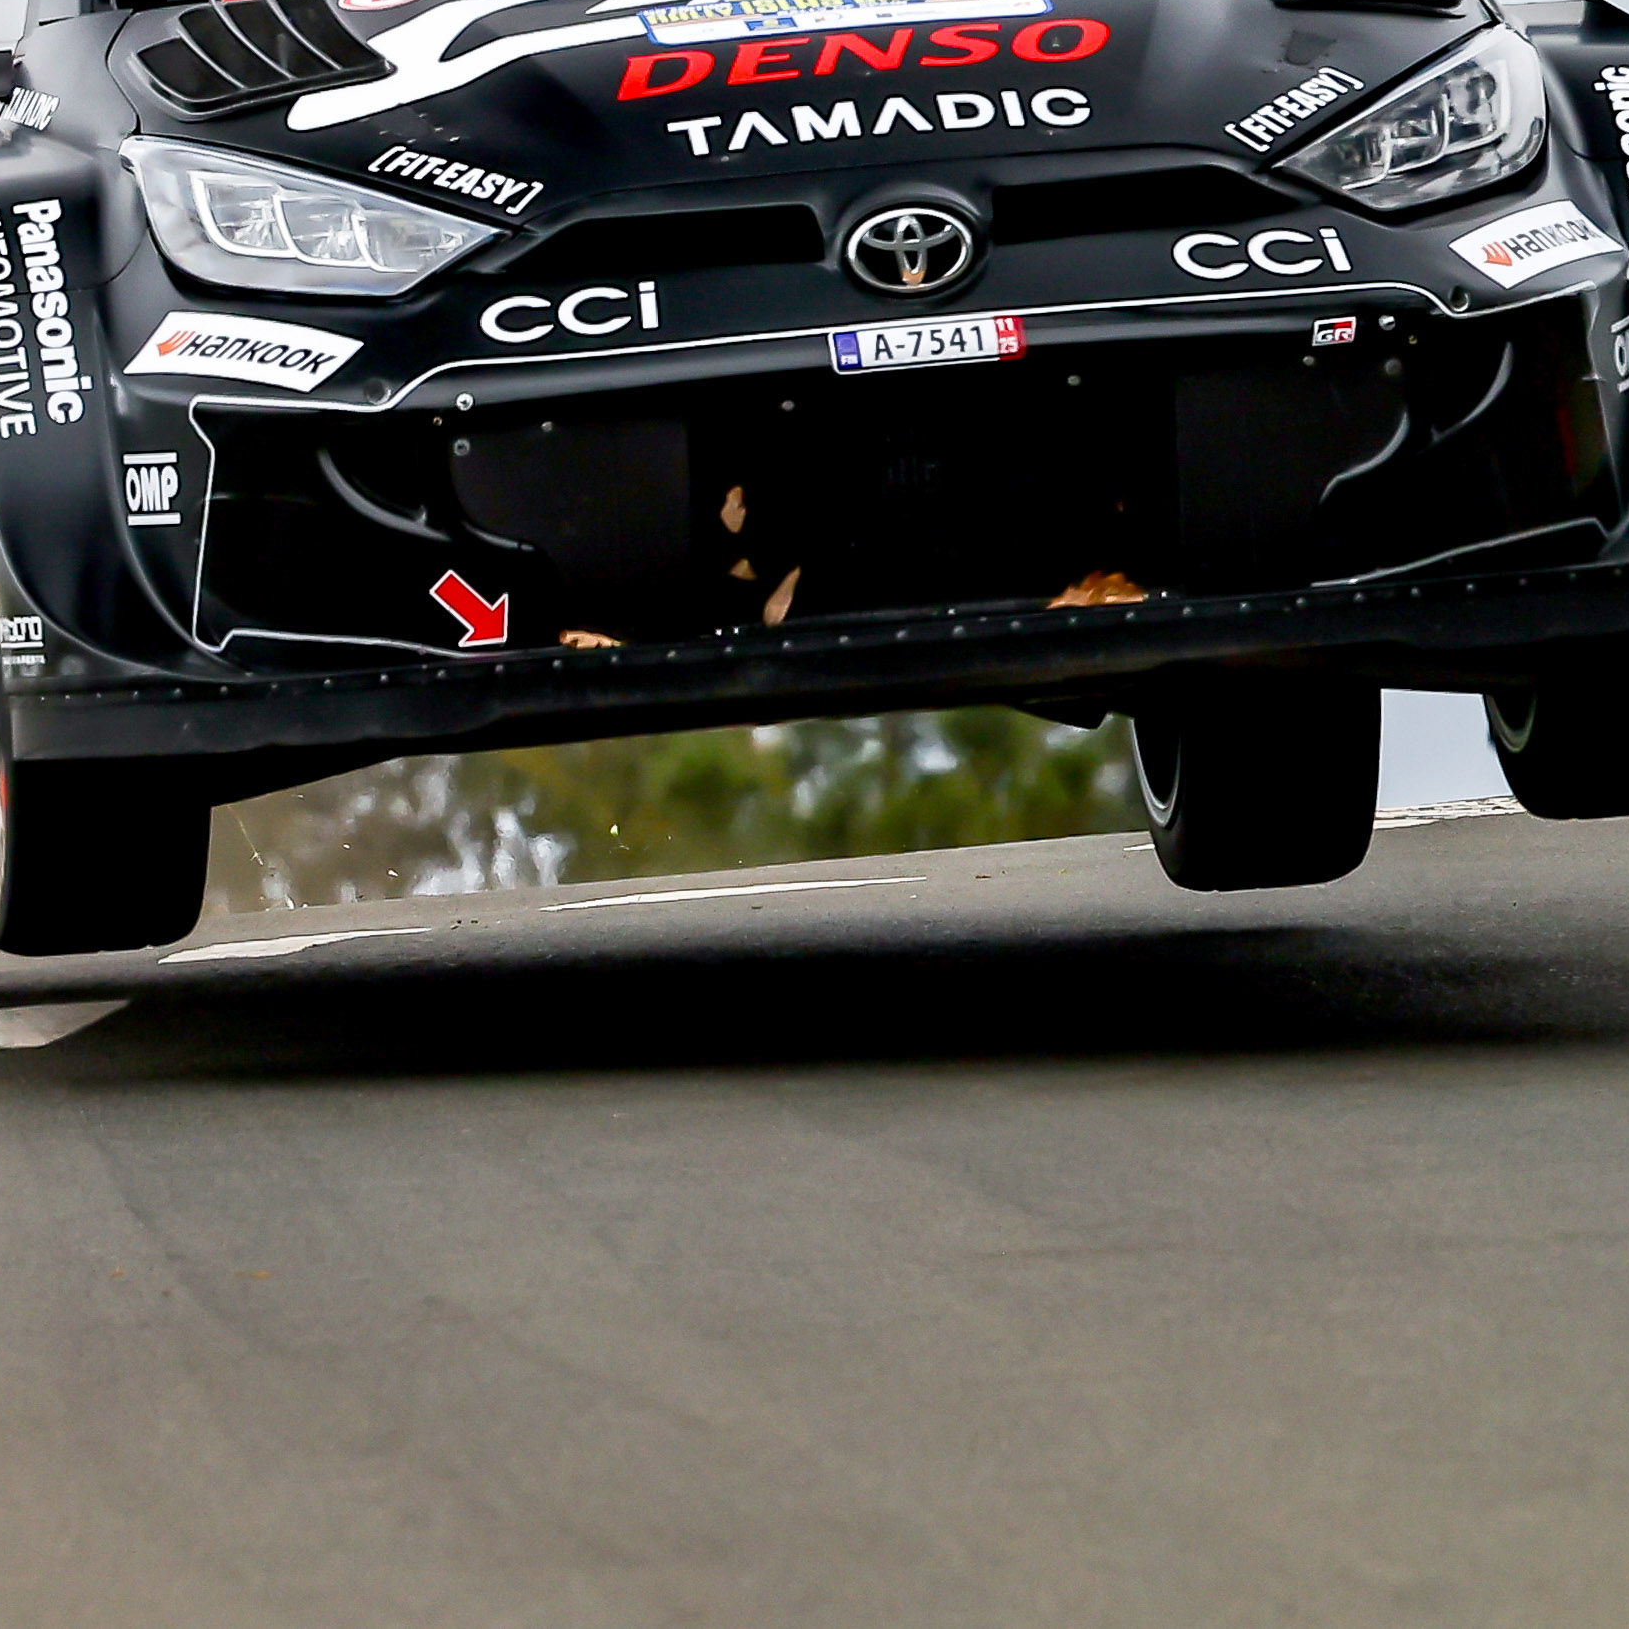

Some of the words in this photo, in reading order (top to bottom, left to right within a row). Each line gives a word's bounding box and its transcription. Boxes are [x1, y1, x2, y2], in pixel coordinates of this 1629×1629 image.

[617, 18, 1111, 101] DENSO
[665, 87, 1092, 157] TAMADIC
[12, 199, 93, 425] Panasonic
[1316, 327, 1353, 343] GR
[874, 325, 984, 361] A-7541
[125, 464, 179, 512] OMP
